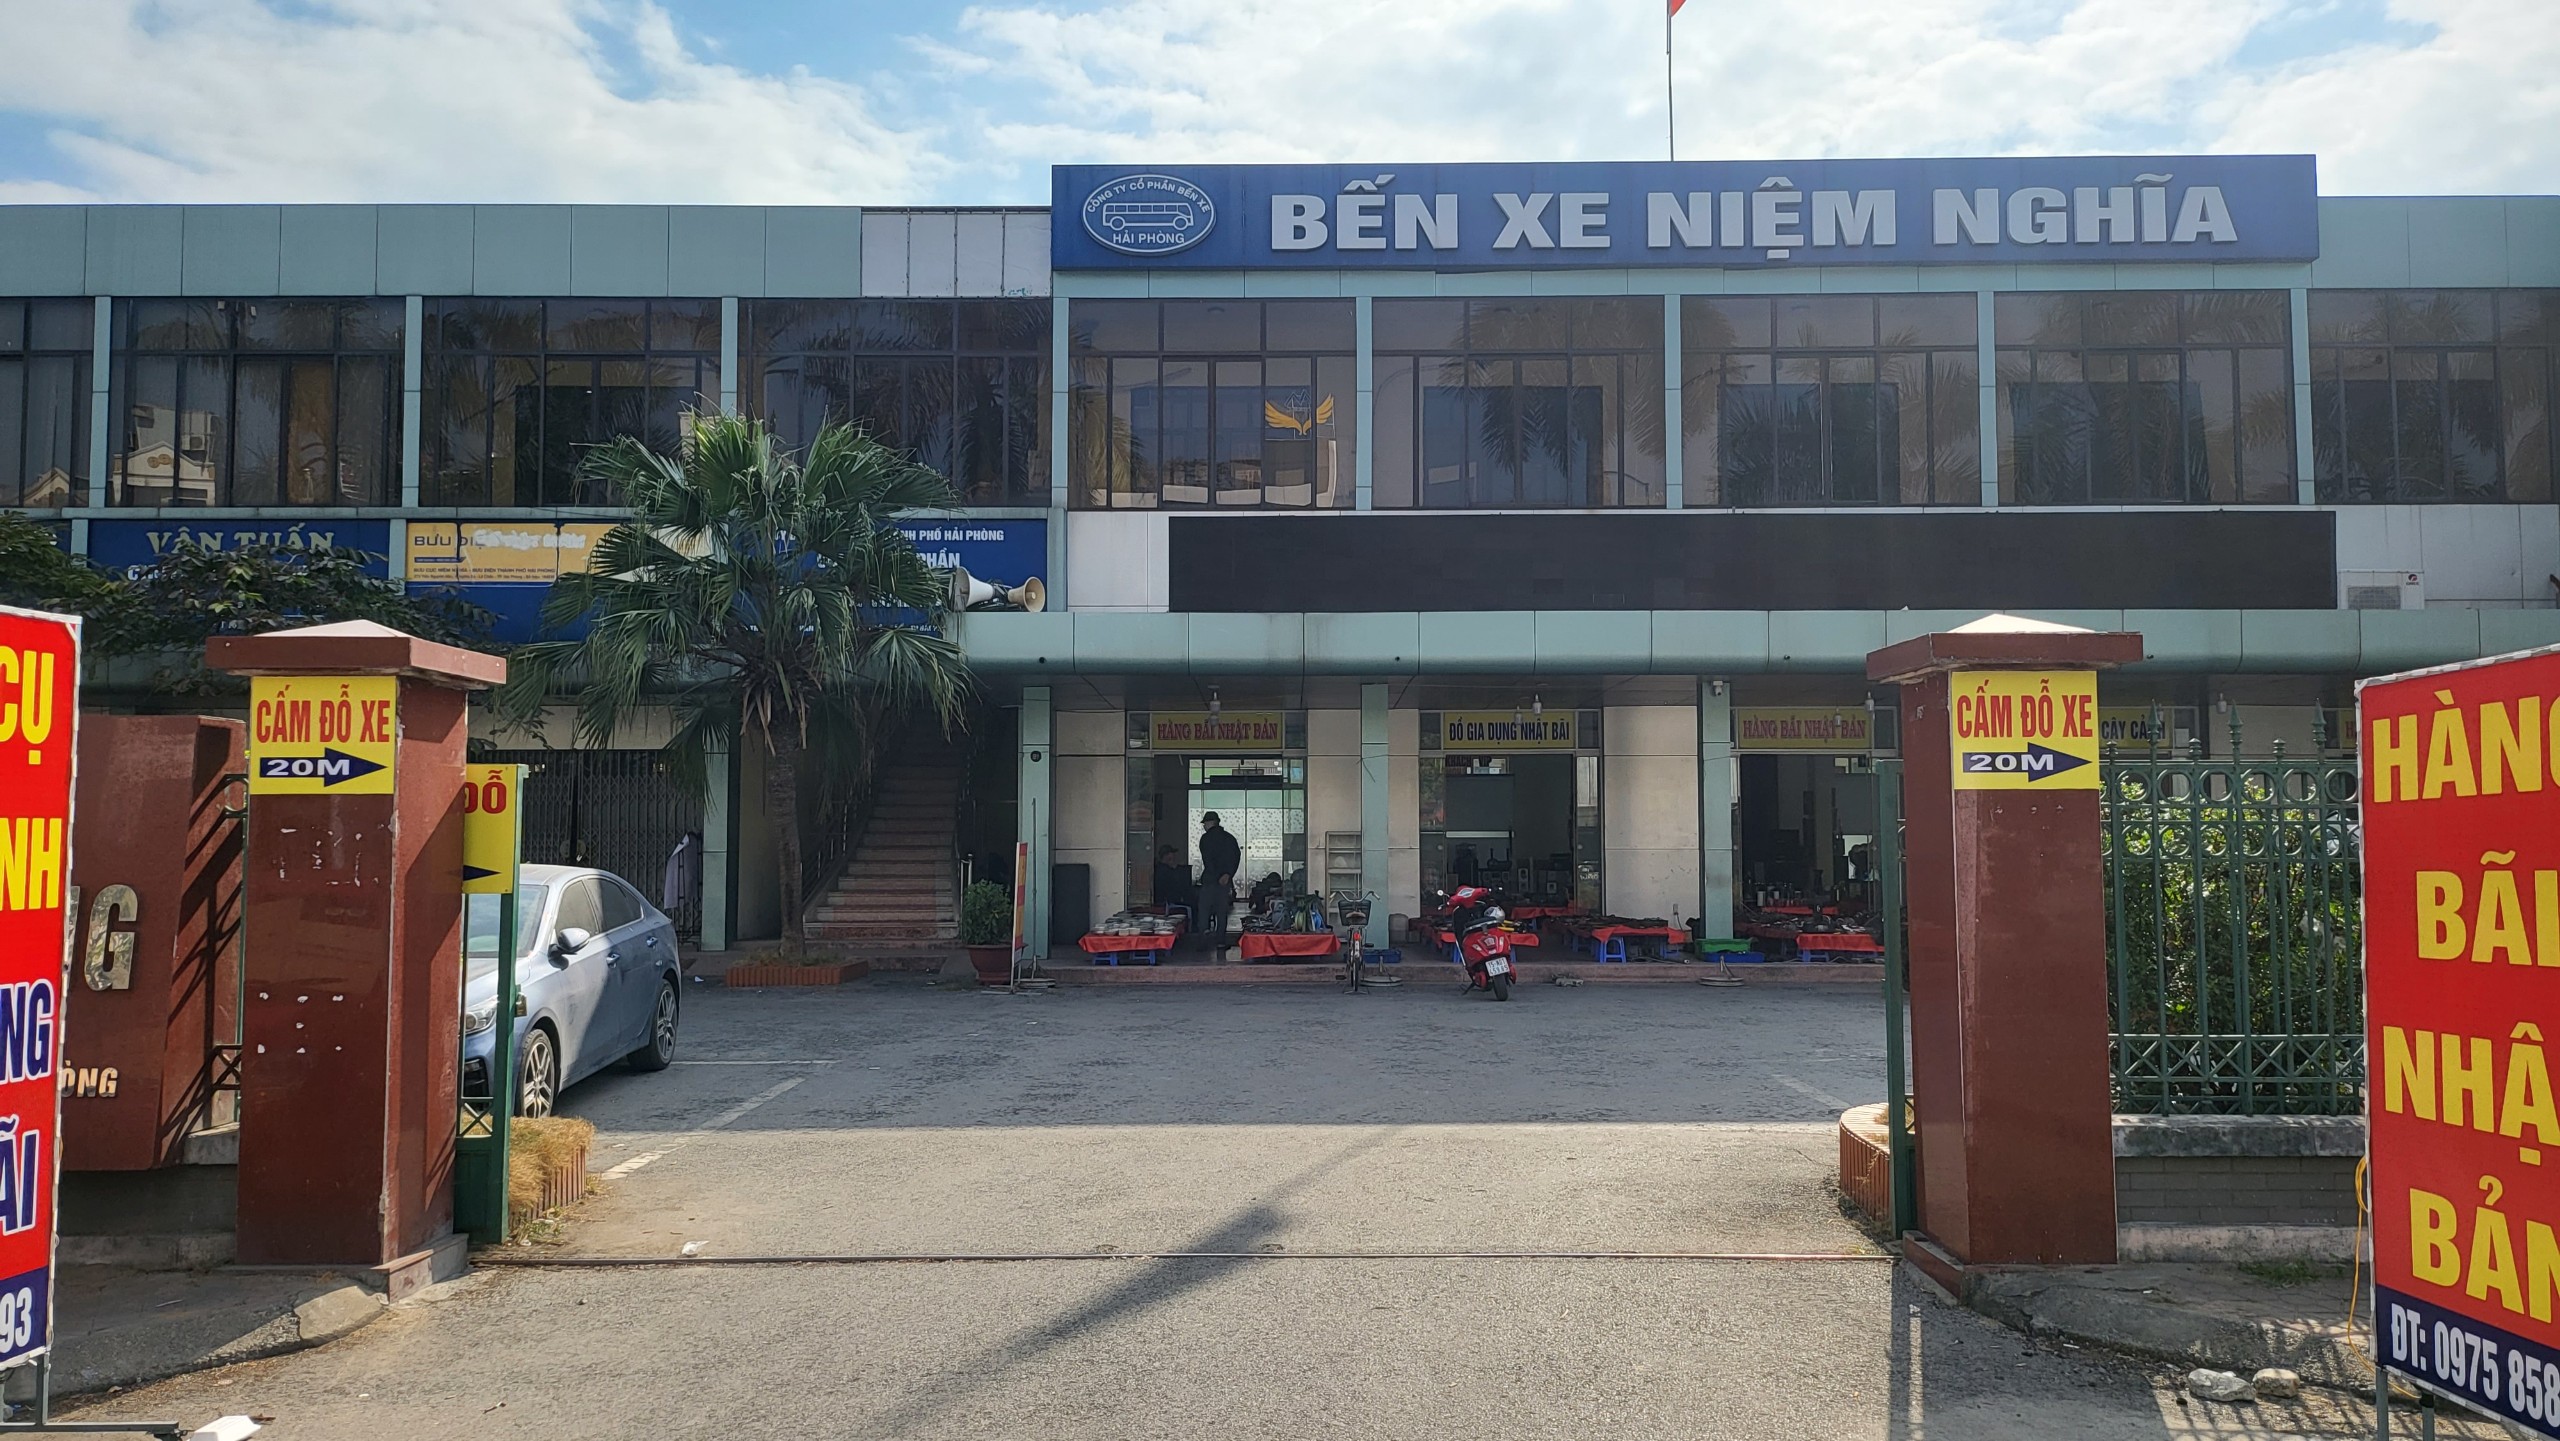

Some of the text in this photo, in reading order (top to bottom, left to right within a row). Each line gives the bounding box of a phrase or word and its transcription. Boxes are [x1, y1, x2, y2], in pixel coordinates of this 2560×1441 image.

[1087, 190, 1113, 213] CÔNG
[1113, 184, 1126, 194] TY
[1147, 179, 1175, 191] PHẦN
[1177, 186, 1198, 201] BẾN
[1197, 199, 1210, 213] XE
[1271, 173, 2238, 259] BẾN XE NIỆM NGHĨA
[1113, 230, 1185, 244] HẢI PHÒNG
[414, 533, 451, 546] BƯU
[919, 526, 942, 541] PHỐ
[945, 527, 963, 541] HẢI
[966, 528, 1004, 541] PHÒNG
[0, 645, 54, 765] CỤ
[256, 684, 390, 743] CẤM ĐỖ XE
[1957, 678, 2093, 738] CẤM ĐỖ XE
[1157, 719, 1191, 740] HÀNG
[1217, 718, 1251, 744] NHẬT
[1253, 718, 1278, 740] BẢN
[1449, 716, 1569, 744] ĐỒ GIA DỤNG NHẬT BÃI
[1743, 714, 1778, 739] HÀNG
[1804, 714, 1837, 743] NHẬT
[1840, 714, 1866, 738] BẢN
[2101, 713, 2166, 739] CÂY CẢH
[266, 759, 350, 776] 20M
[1969, 754, 2054, 771] 20M
[2416, 850, 2560, 967] BÃI
[0, 1287, 32, 1353] 93
[2391, 1303, 2560, 1427] ĐT: 0975 858
